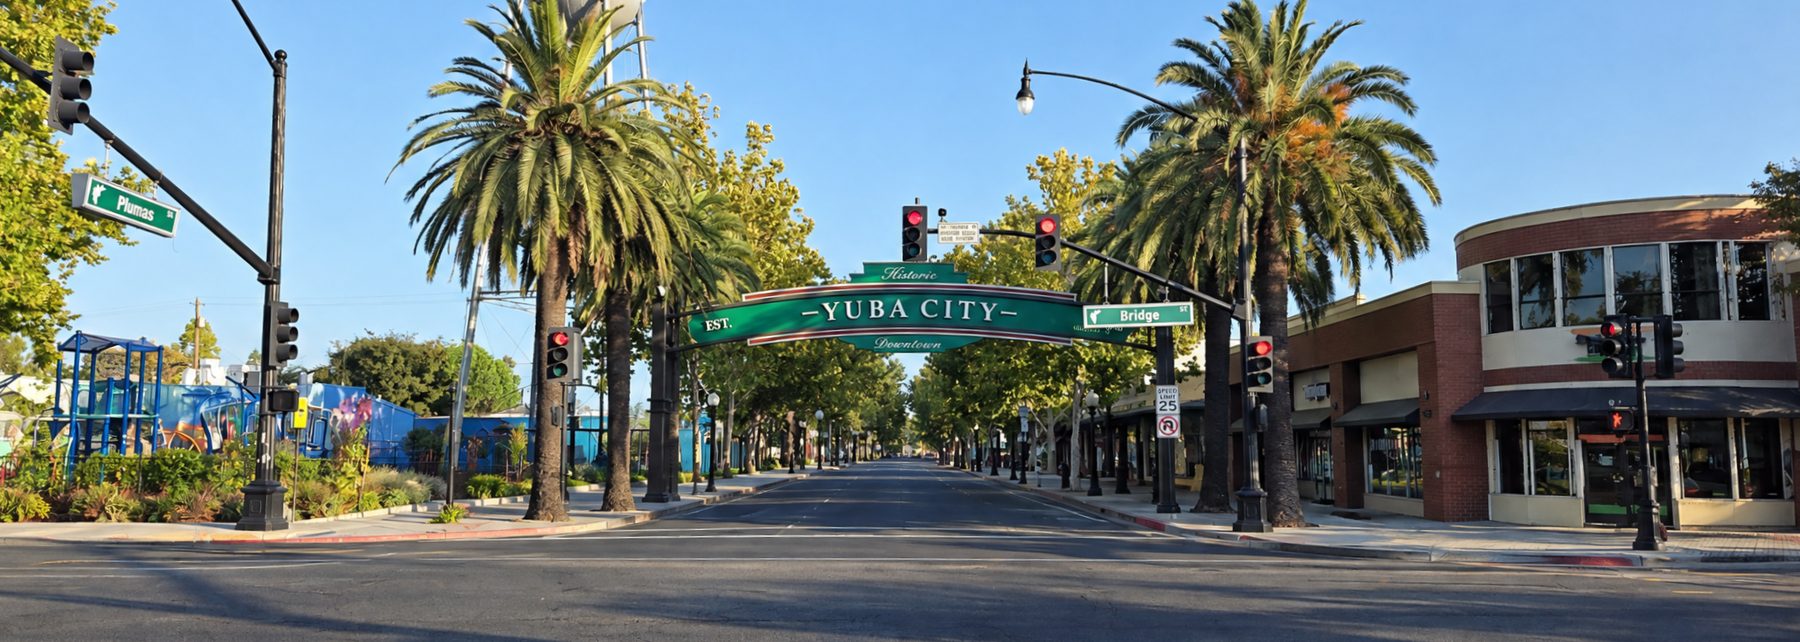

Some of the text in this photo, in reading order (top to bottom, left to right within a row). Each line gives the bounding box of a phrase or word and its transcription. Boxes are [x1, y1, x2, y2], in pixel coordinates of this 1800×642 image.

[117, 195, 154, 221] Plumas
[881, 266, 937, 280] Historic
[821, 299, 998, 322] YUBA CITY
[1120, 309, 1159, 323] Bridge
[705, 317, 732, 331] EST.
[874, 337, 941, 350] Downtown
[1159, 400, 1177, 411] 25
